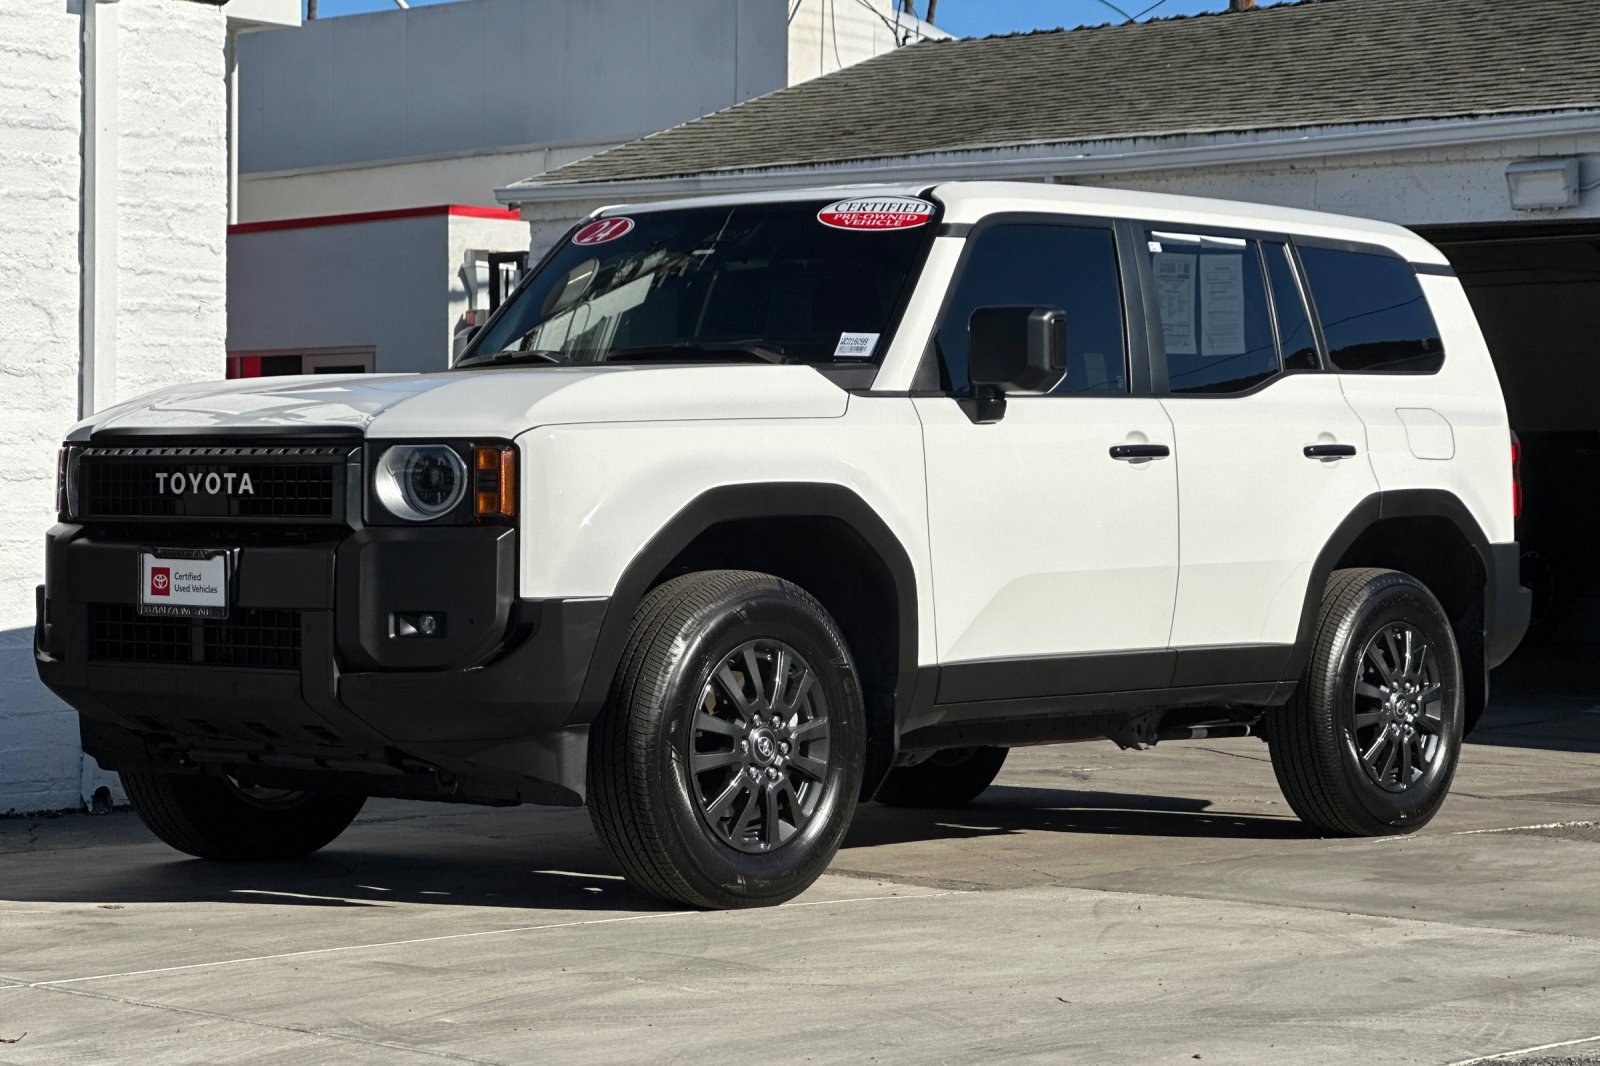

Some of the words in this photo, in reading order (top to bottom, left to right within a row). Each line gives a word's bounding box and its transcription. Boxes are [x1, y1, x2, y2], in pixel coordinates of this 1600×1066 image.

[835, 202, 928, 213] CERTIFIED
[834, 213, 918, 221] PRE-OWNED
[579, 219, 626, 243] 24
[155, 472, 254, 495] TOYOTA
[174, 572, 202, 581] Certified
[174, 584, 190, 593] Used
[191, 584, 218, 594] Vehicles
[181, 607, 221, 616] MNI
